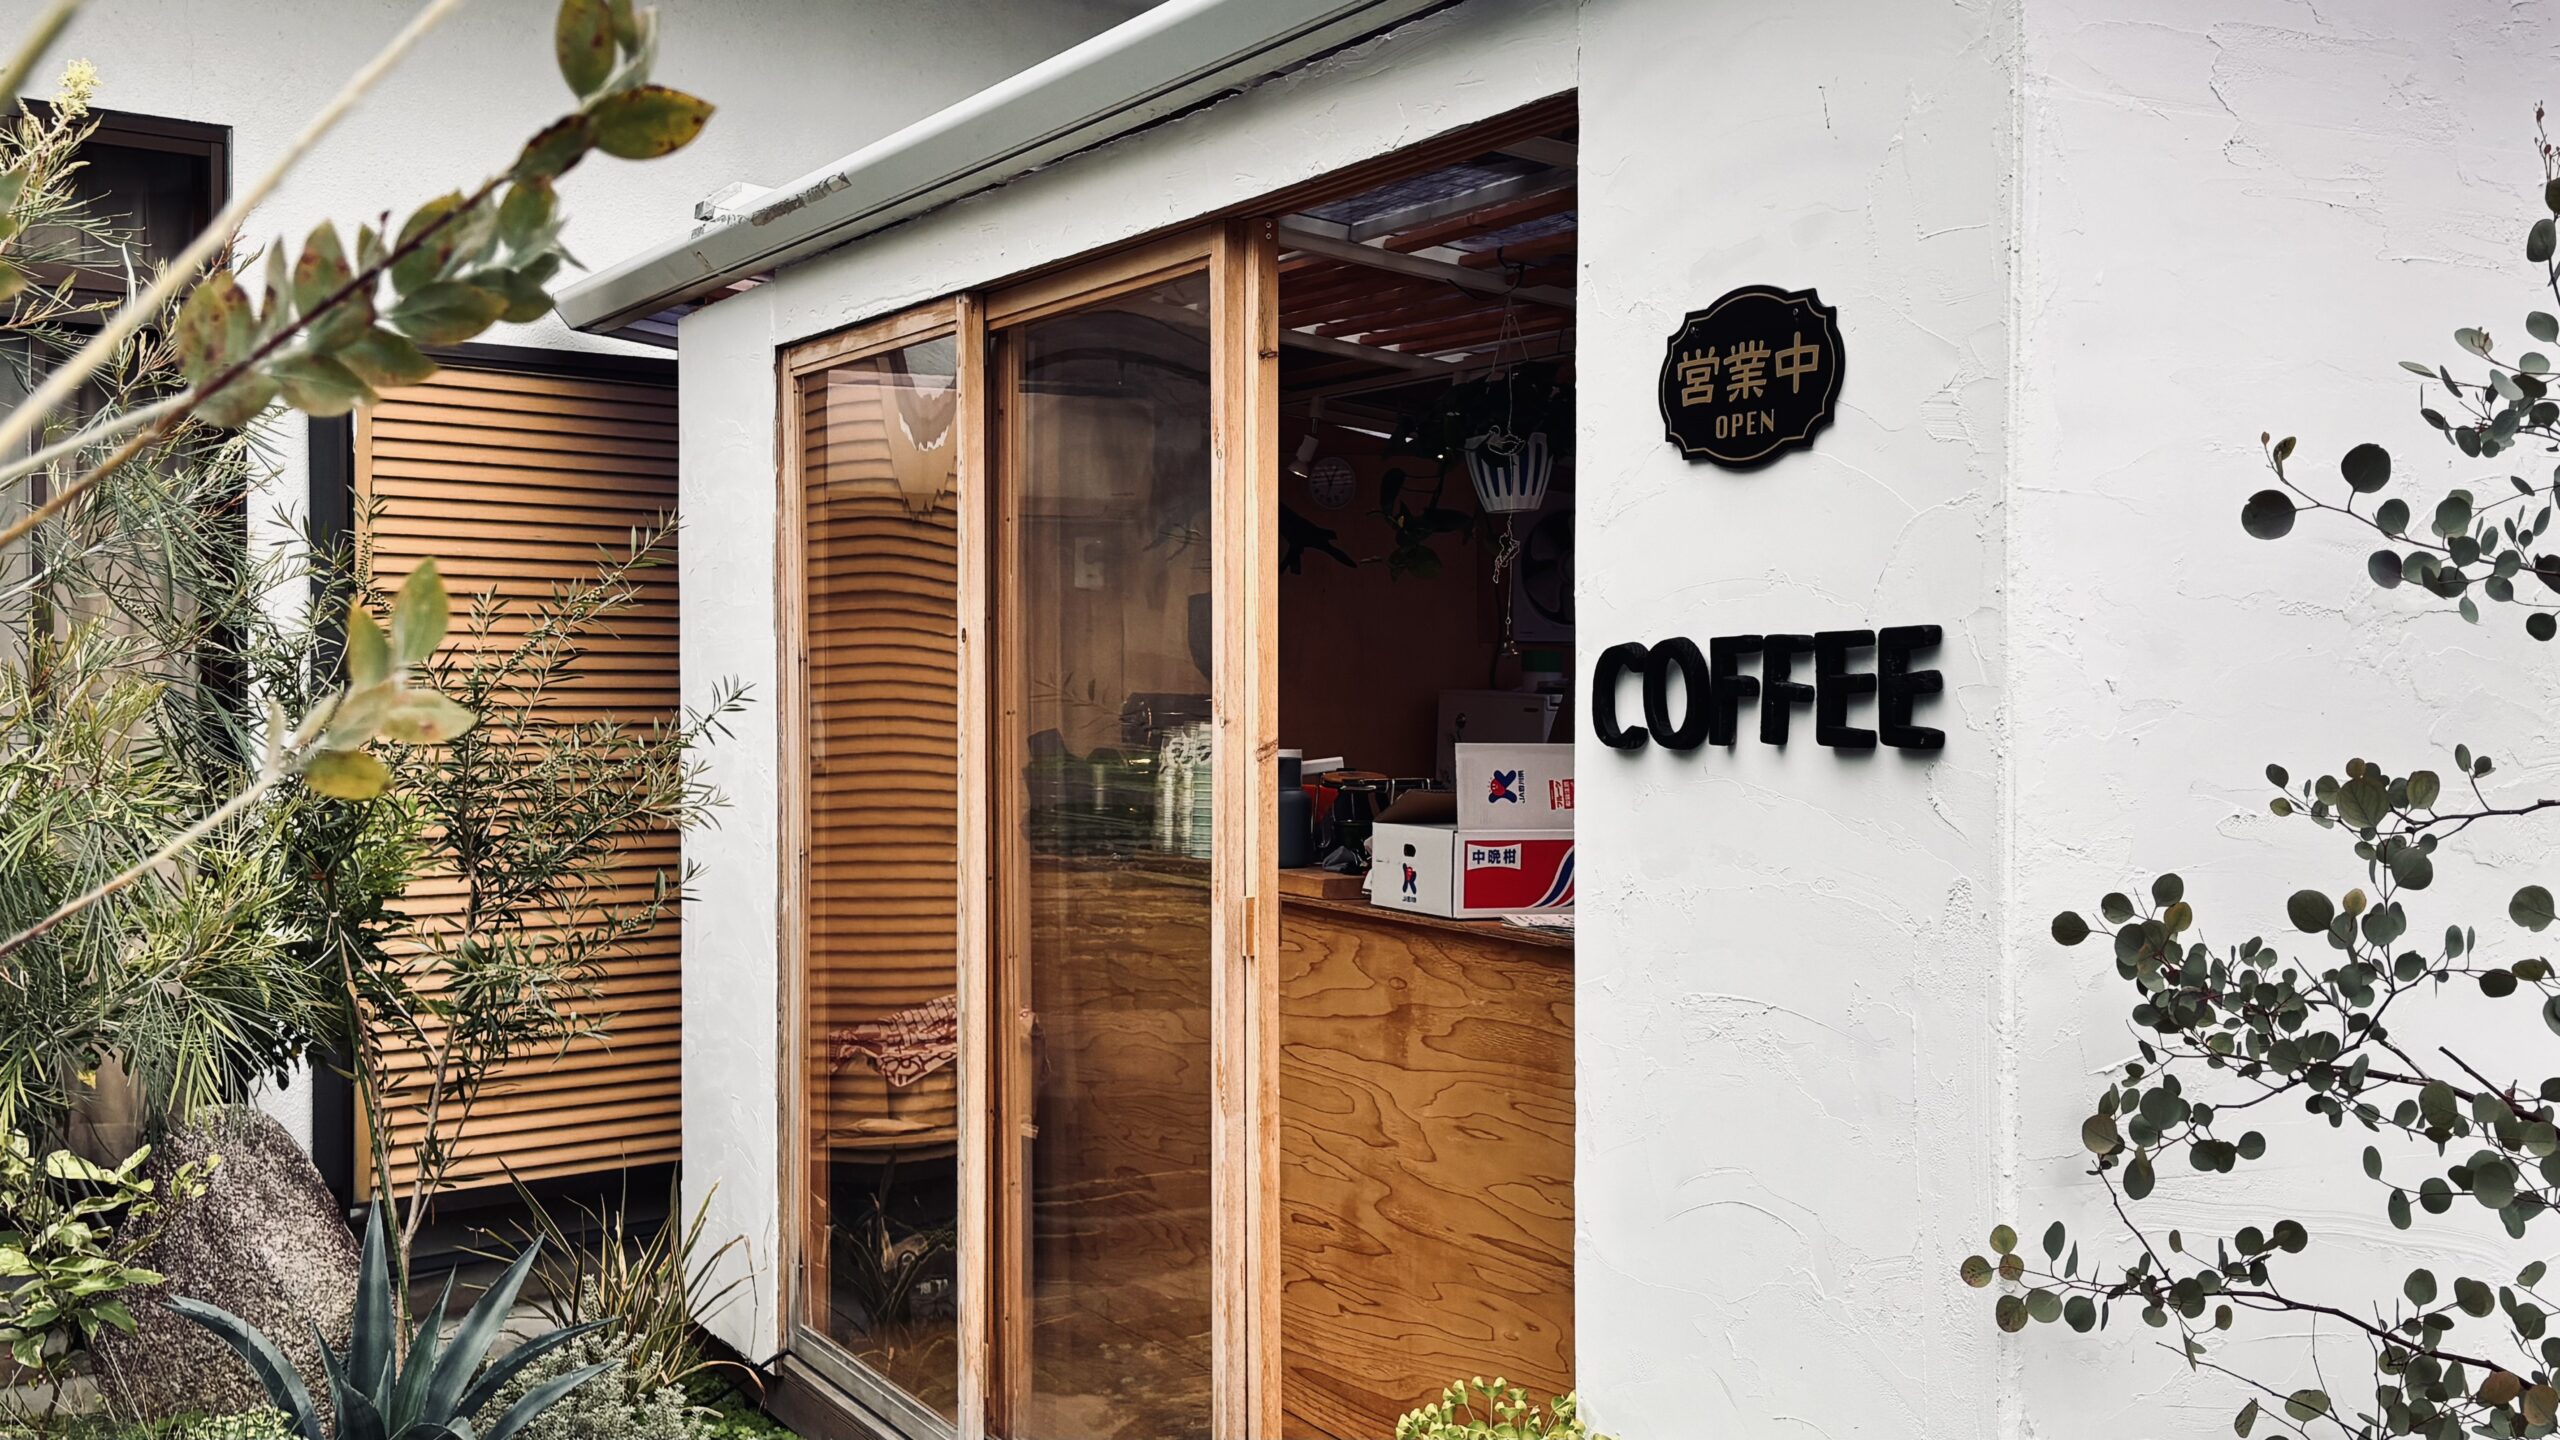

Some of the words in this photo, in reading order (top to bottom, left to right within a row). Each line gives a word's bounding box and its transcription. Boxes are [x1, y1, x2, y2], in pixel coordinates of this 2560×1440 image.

[1677, 331, 1820, 407] 営業中
[1715, 409, 1775, 439] OPEN
[1592, 625, 1945, 750] COFFEE
[1472, 848, 1517, 865] 中晩柑
